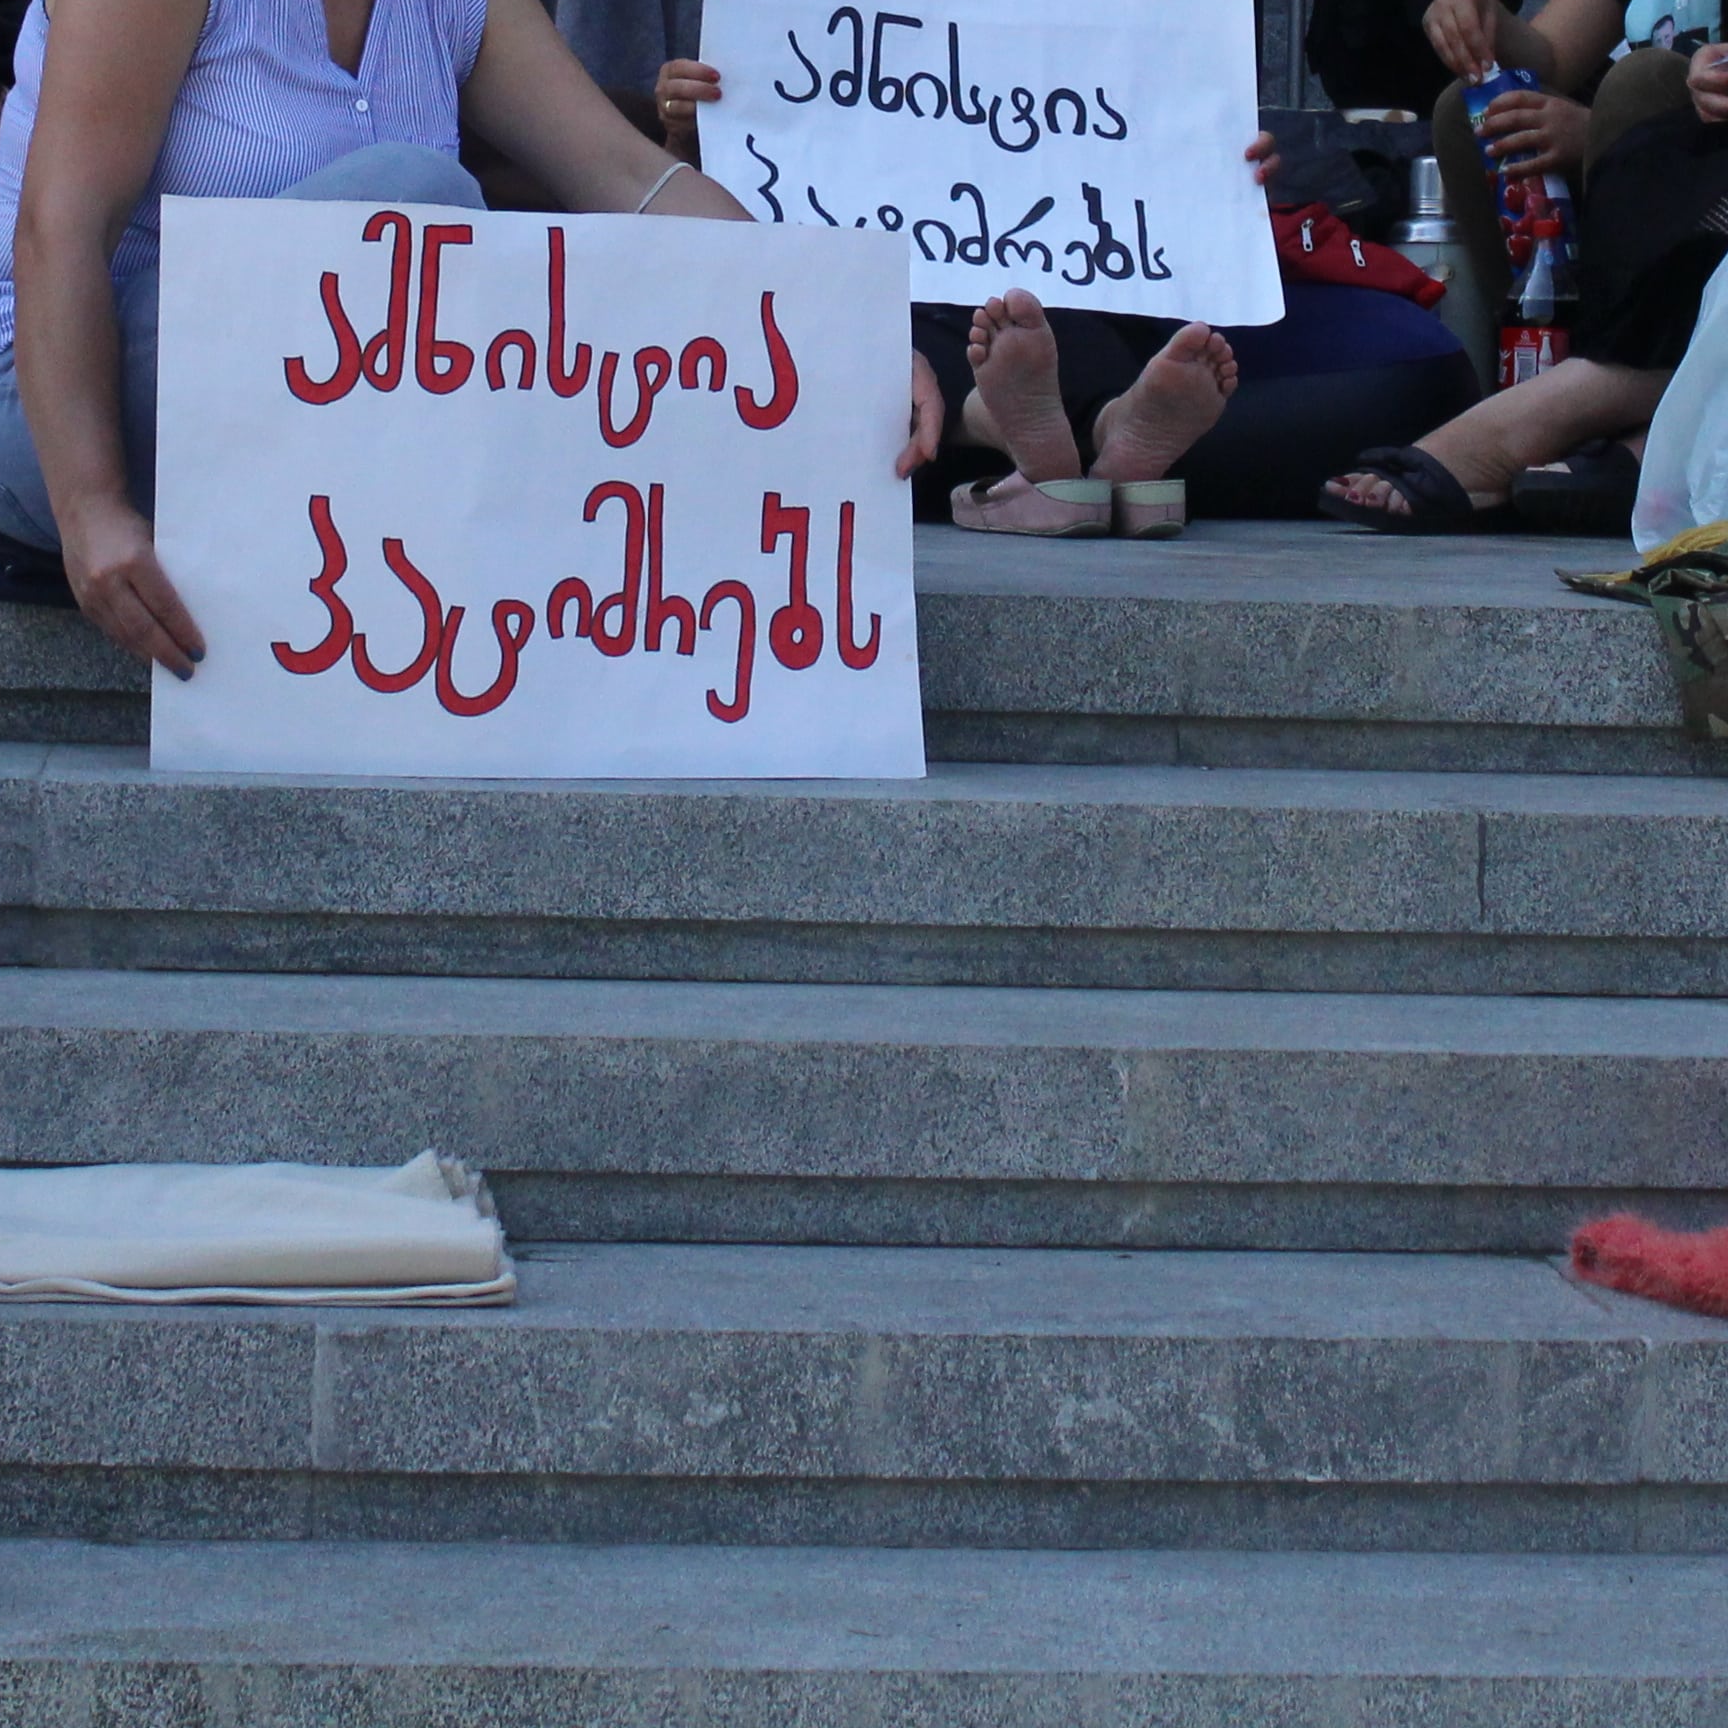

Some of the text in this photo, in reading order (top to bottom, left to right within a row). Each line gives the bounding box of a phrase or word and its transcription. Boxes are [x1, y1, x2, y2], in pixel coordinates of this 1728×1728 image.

[775, 7, 1126, 151] ამნისტია
[284, 209, 800, 448] ამნისტია
[271, 479, 882, 724] პატიმრებს
